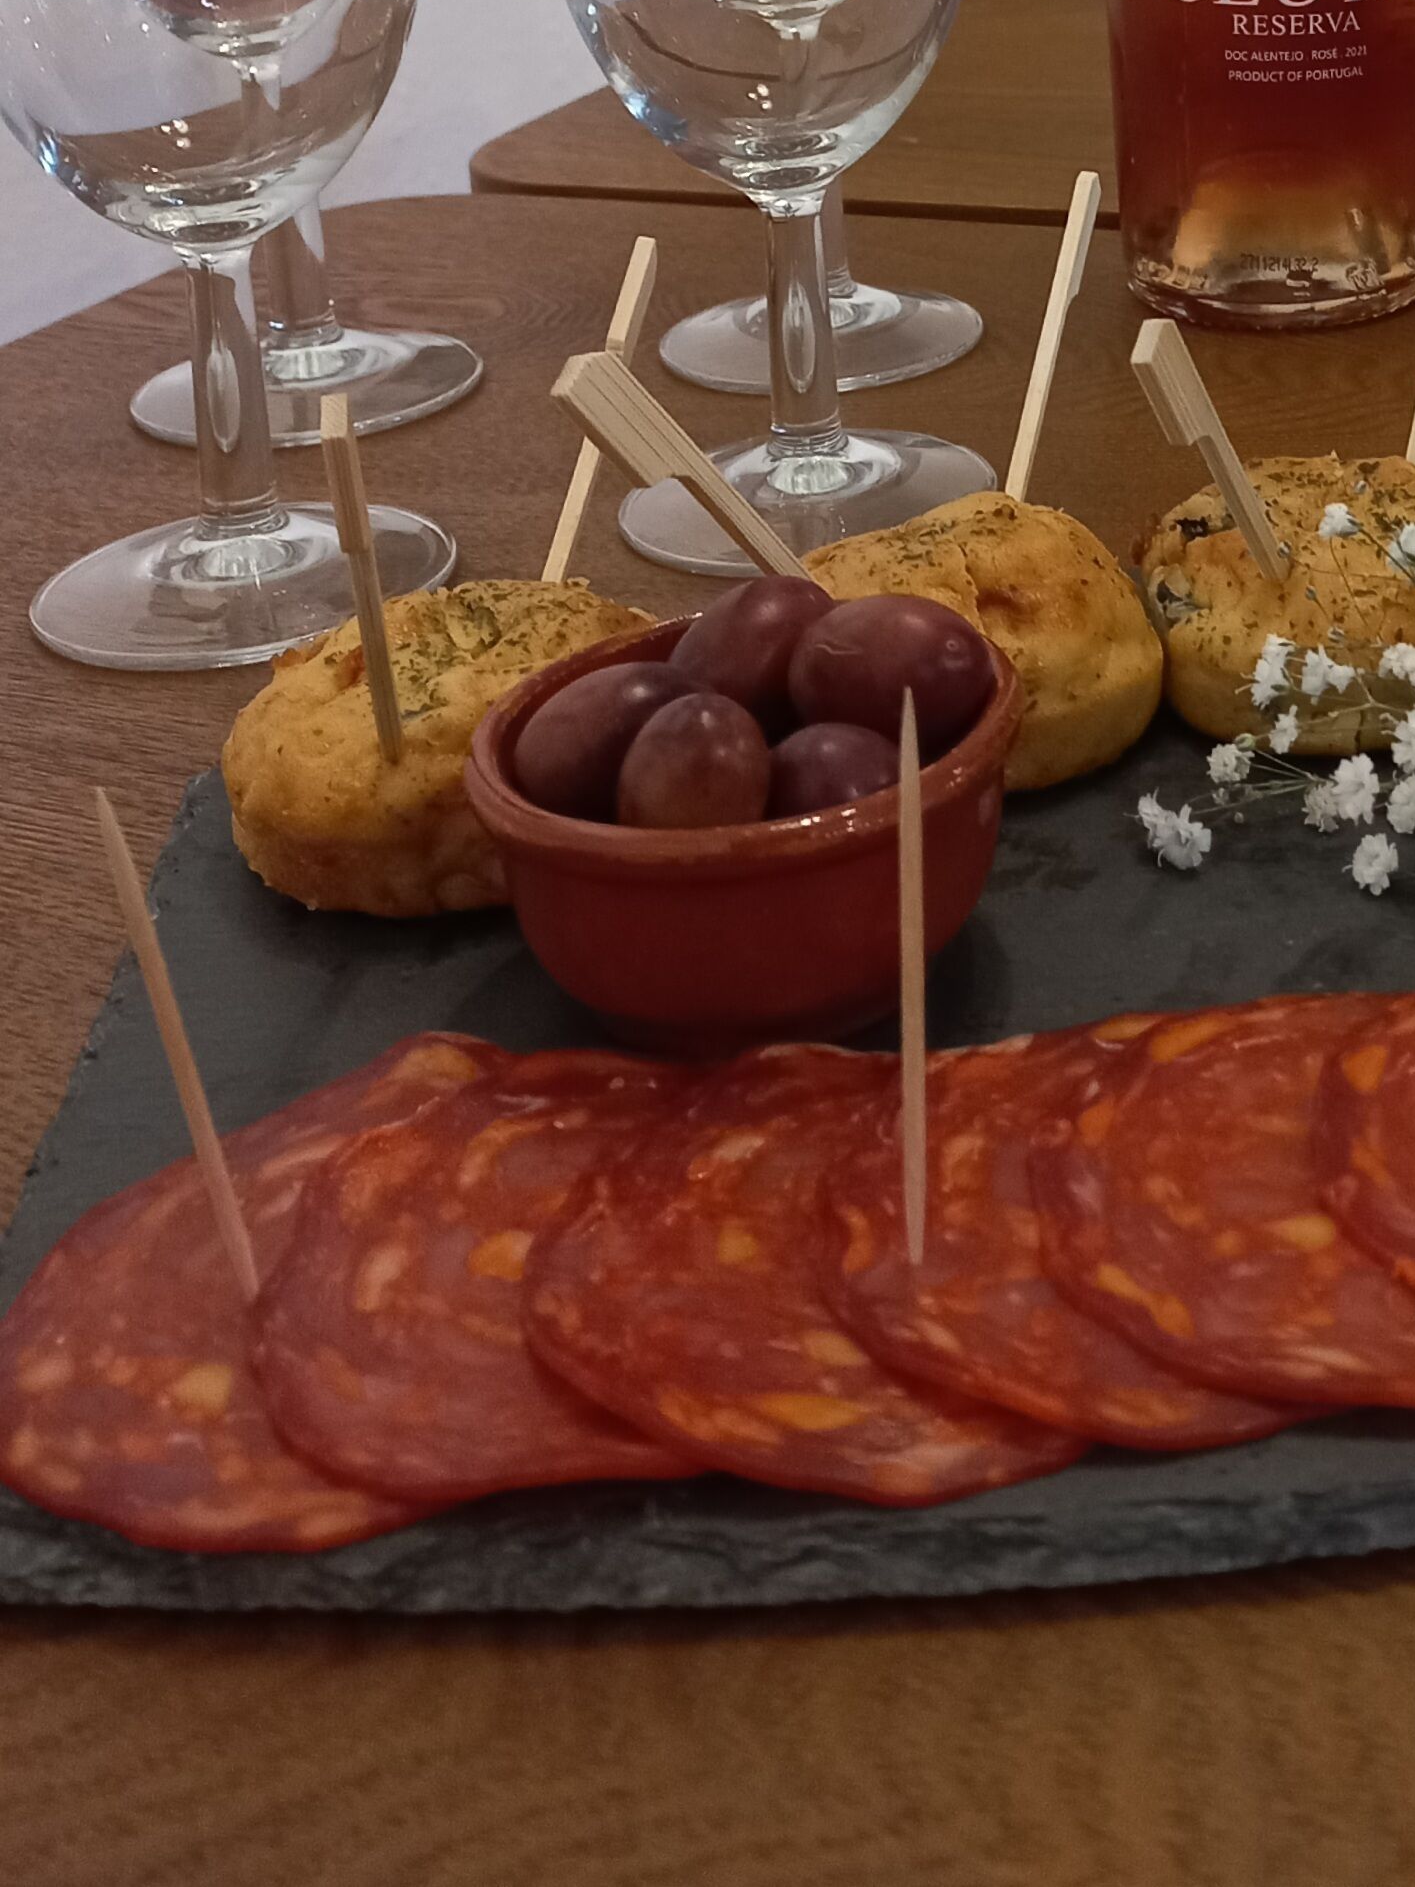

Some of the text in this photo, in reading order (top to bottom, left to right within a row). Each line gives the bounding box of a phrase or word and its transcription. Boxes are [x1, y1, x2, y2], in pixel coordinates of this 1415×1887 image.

[1232, 10, 1361, 36] RESERVA
[1224, 44, 1368, 62] DOC ALENTEJO ROSÉ 2021
[1228, 66, 1364, 83] PRODUCT OF PORTUGAL
